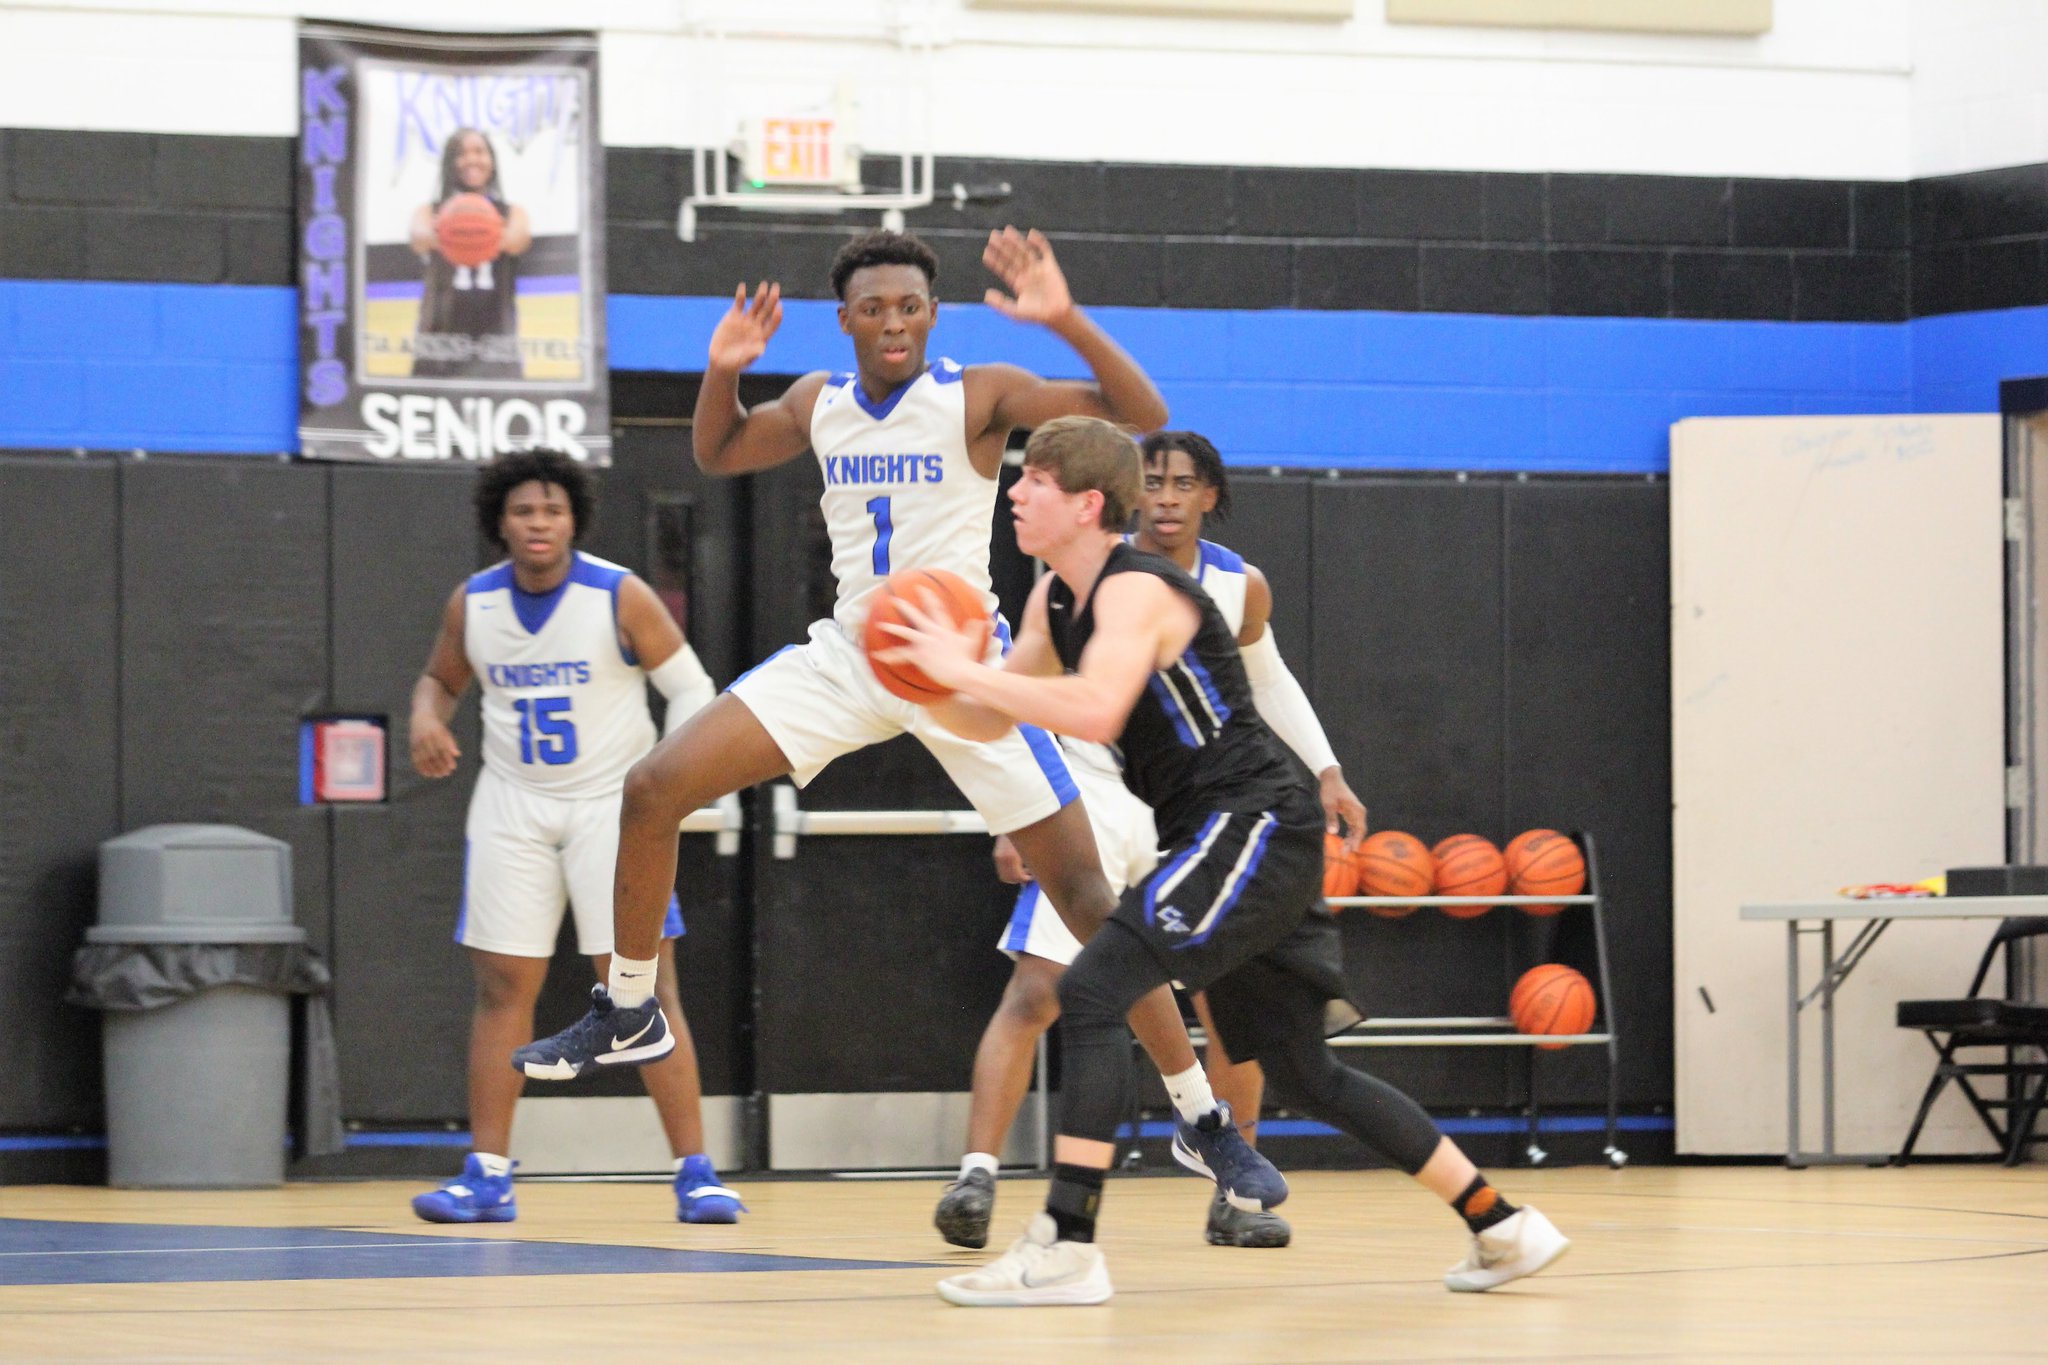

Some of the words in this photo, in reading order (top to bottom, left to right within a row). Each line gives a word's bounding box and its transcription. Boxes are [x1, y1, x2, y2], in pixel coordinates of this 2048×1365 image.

[764, 119, 834, 179] EXIT
[302, 66, 349, 406] KNIGHTS
[361, 393, 588, 461] SENIOR
[825, 454, 943, 484] KNIGHTS
[866, 496, 893, 575] 1
[486, 660, 591, 687] KNIGHTS
[513, 697, 577, 765] 15
